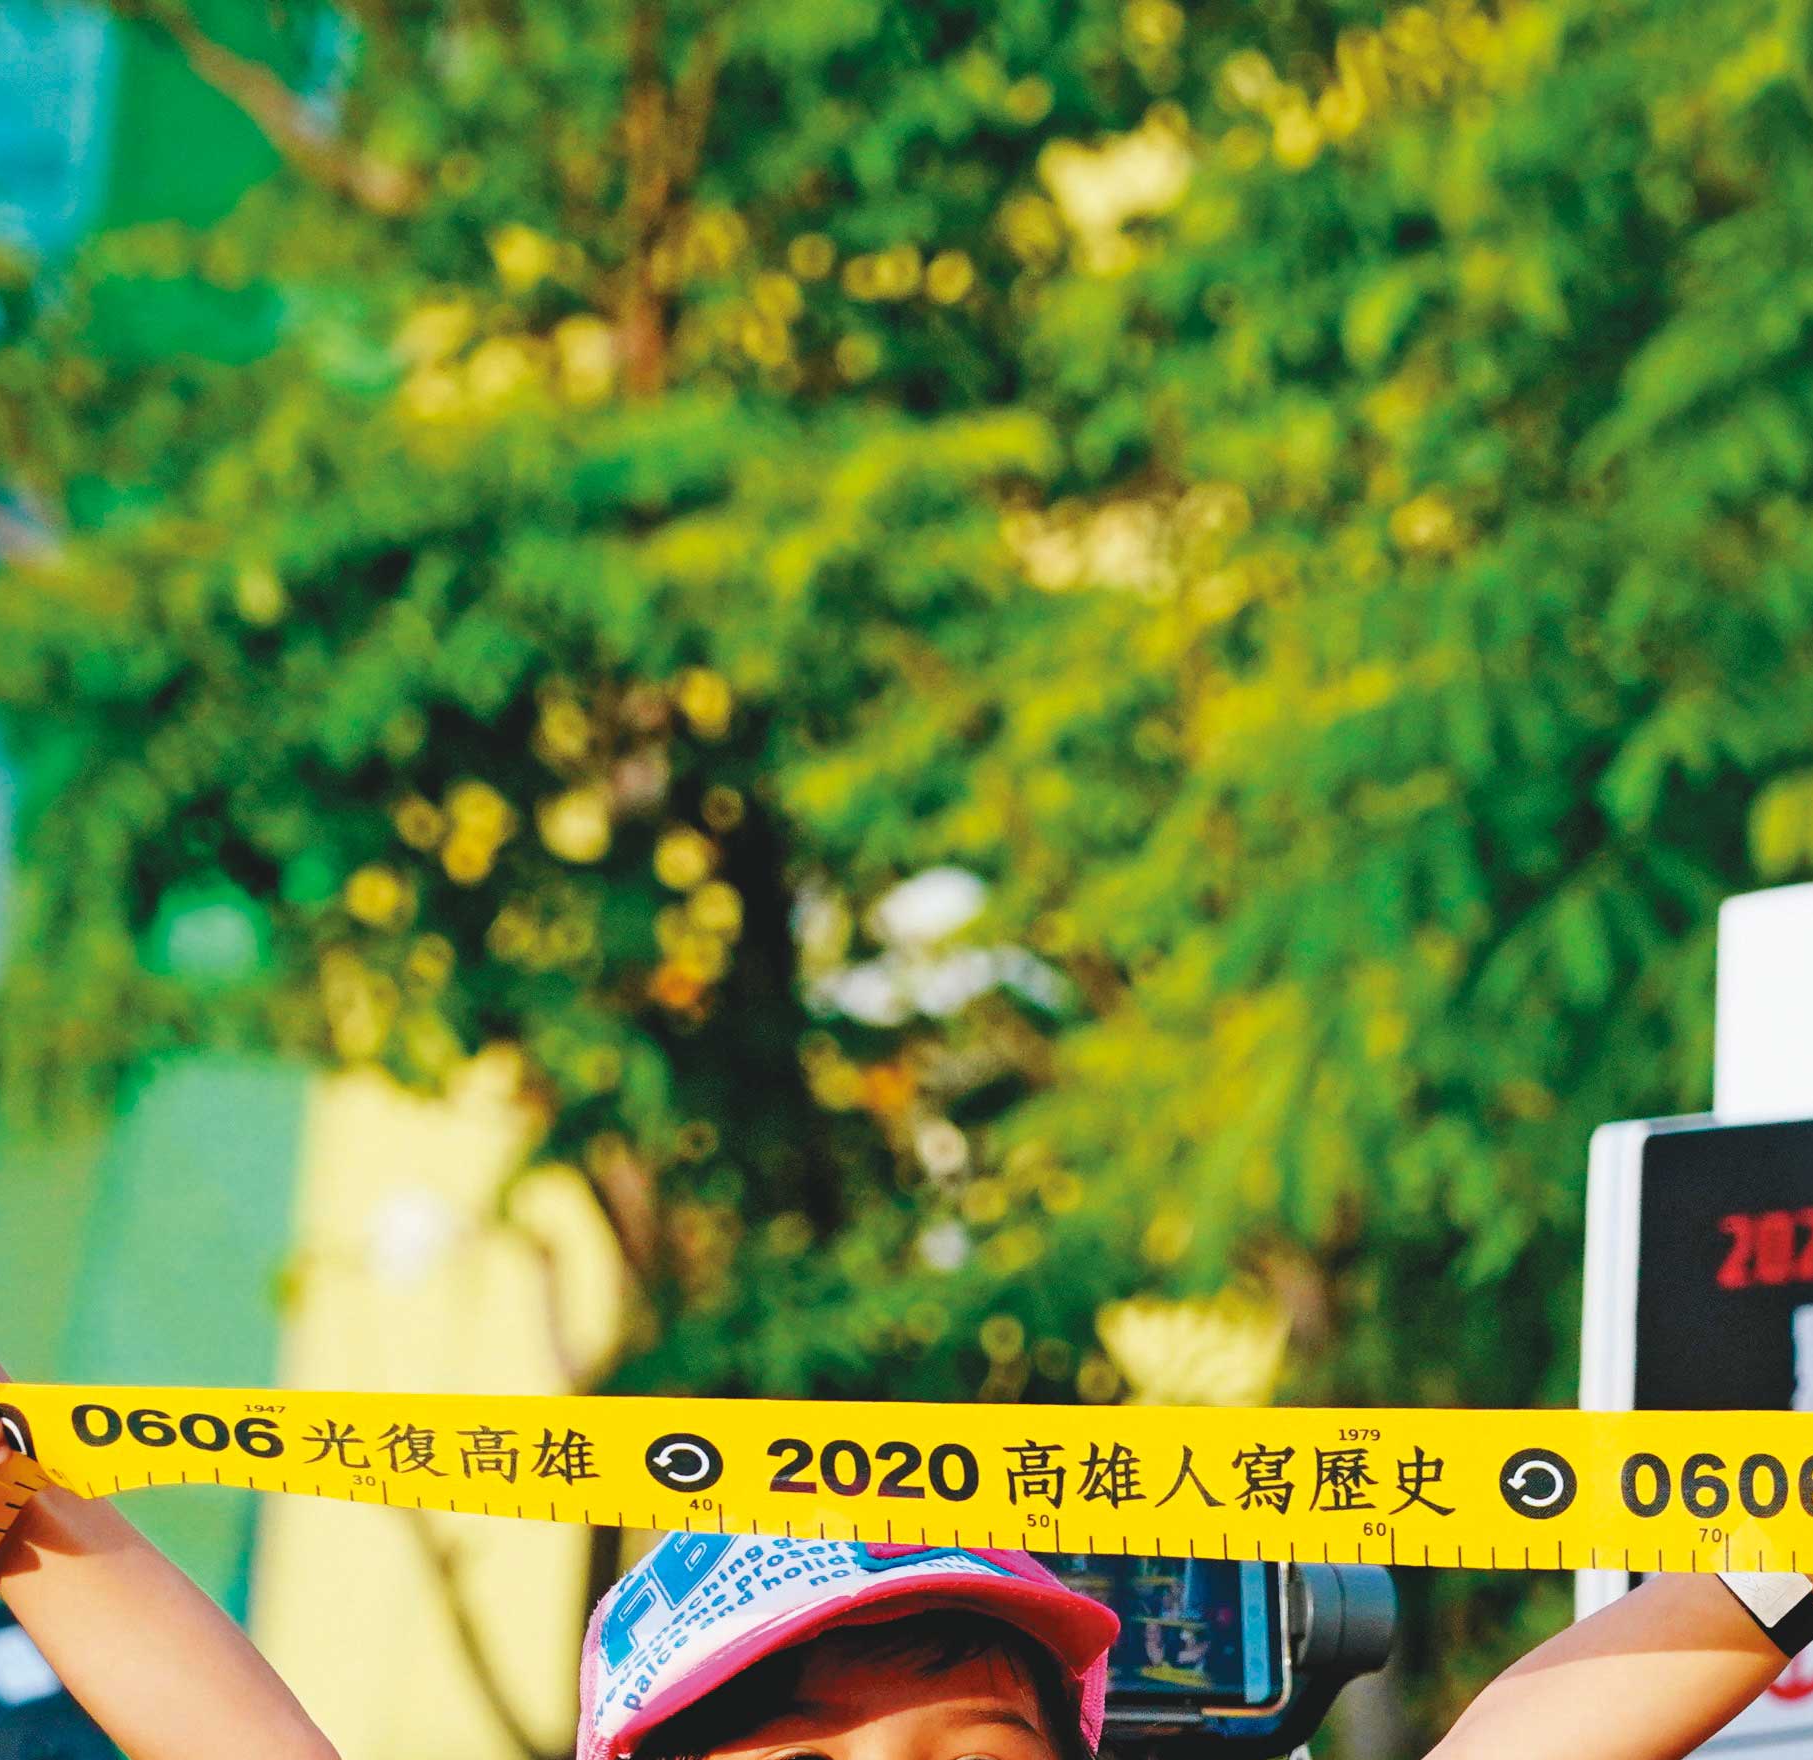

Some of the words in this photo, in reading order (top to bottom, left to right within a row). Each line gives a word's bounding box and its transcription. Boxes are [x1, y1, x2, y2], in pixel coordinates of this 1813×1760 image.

[242, 1403, 286, 1415] 1947
[1336, 1429, 1382, 1442] 1979
[70, 1403, 285, 1459] 0606
[301, 1417, 601, 1485] 光復高雄
[767, 1438, 980, 1502] 2020
[1002, 1438, 1457, 1518] 高雄人寫歷史
[352, 1474, 378, 1487] 30
[688, 1499, 714, 1512] 40
[1025, 1514, 1051, 1527] 50
[1362, 1522, 1387, 1538] 60
[1699, 1528, 1723, 1543] 70
